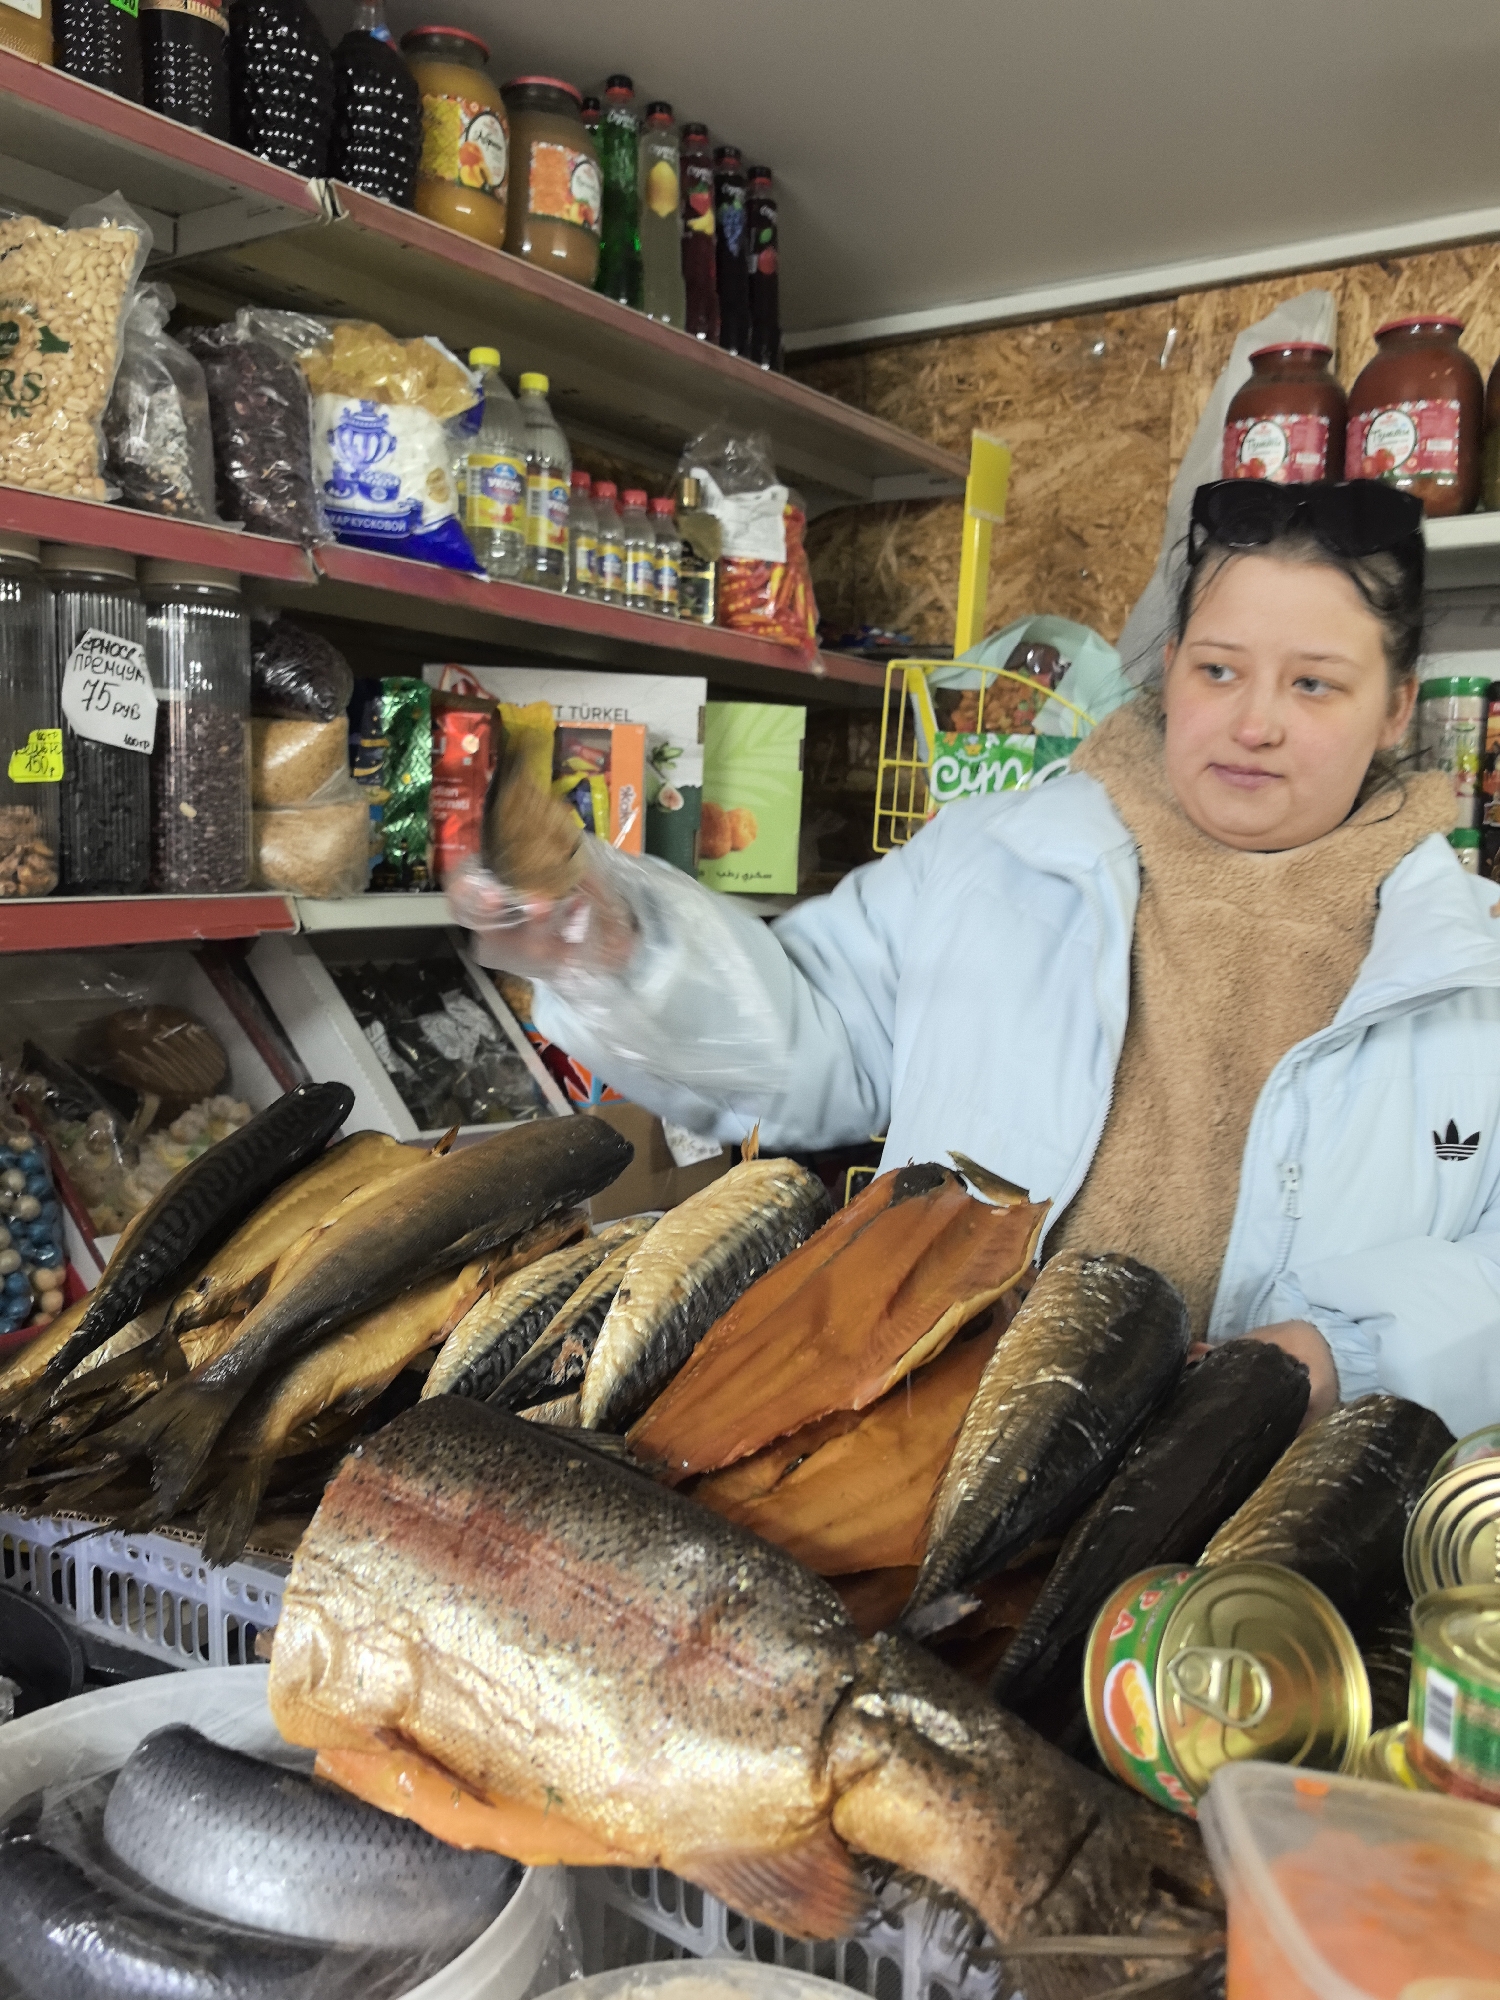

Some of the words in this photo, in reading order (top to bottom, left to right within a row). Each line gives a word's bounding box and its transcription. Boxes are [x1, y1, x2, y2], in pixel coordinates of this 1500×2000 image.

[487, 477, 522, 493] УКСУС
[351, 517, 407, 533] КУСКОВОЙ
[81, 679, 121, 712] 75
[568, 703, 634, 724] TÜRKEL
